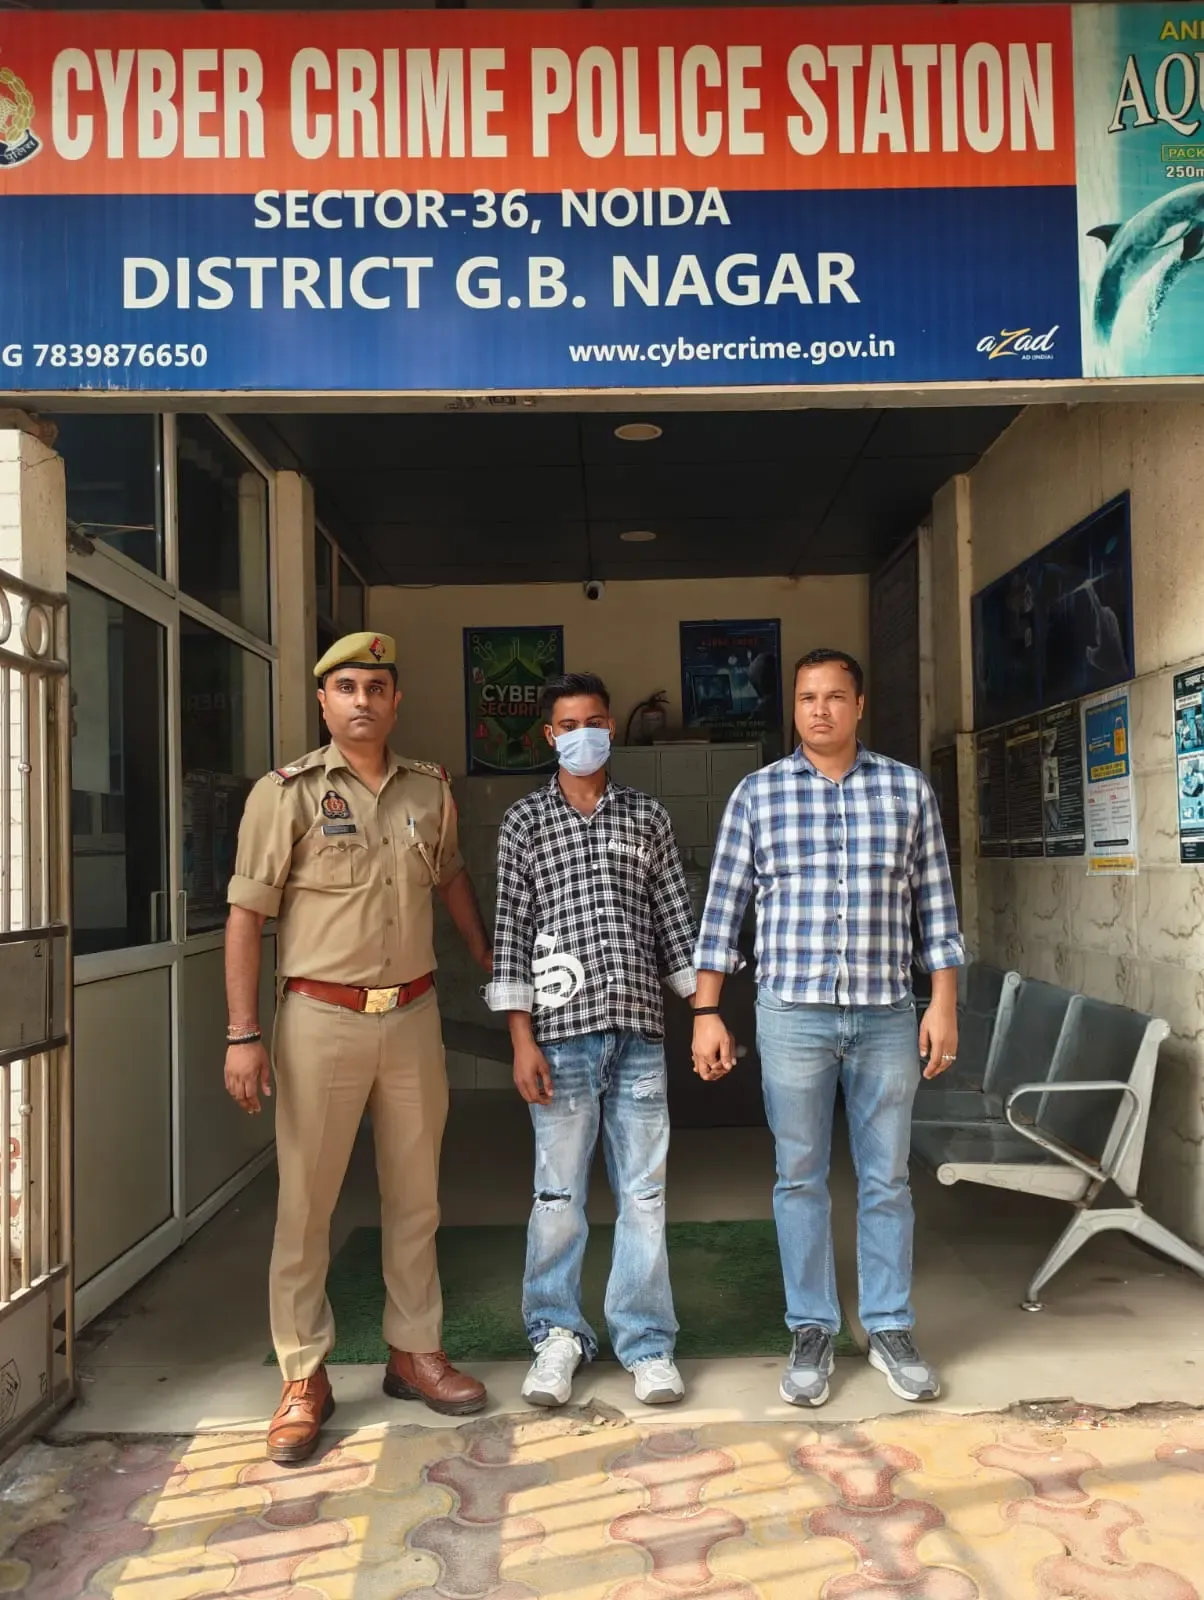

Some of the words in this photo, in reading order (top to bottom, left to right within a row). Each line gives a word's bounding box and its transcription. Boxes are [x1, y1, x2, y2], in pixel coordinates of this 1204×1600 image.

[51, 48, 266, 161] CYBER
[290, 47, 508, 160] CRIME
[531, 46, 765, 159] POLICE
[787, 42, 1056, 157] STATION
[253, 188, 542, 234] SECTOR-36,
[561, 187, 732, 228] NOIDA
[122, 256, 435, 311] DISTRICT
[455, 256, 587, 310] G.B.
[612, 252, 862, 308] NAGAR
[2, 344, 23, 367] G
[33, 343, 208, 367] 7839876650
[568, 334, 896, 367] www.cybercrime.gov.in
